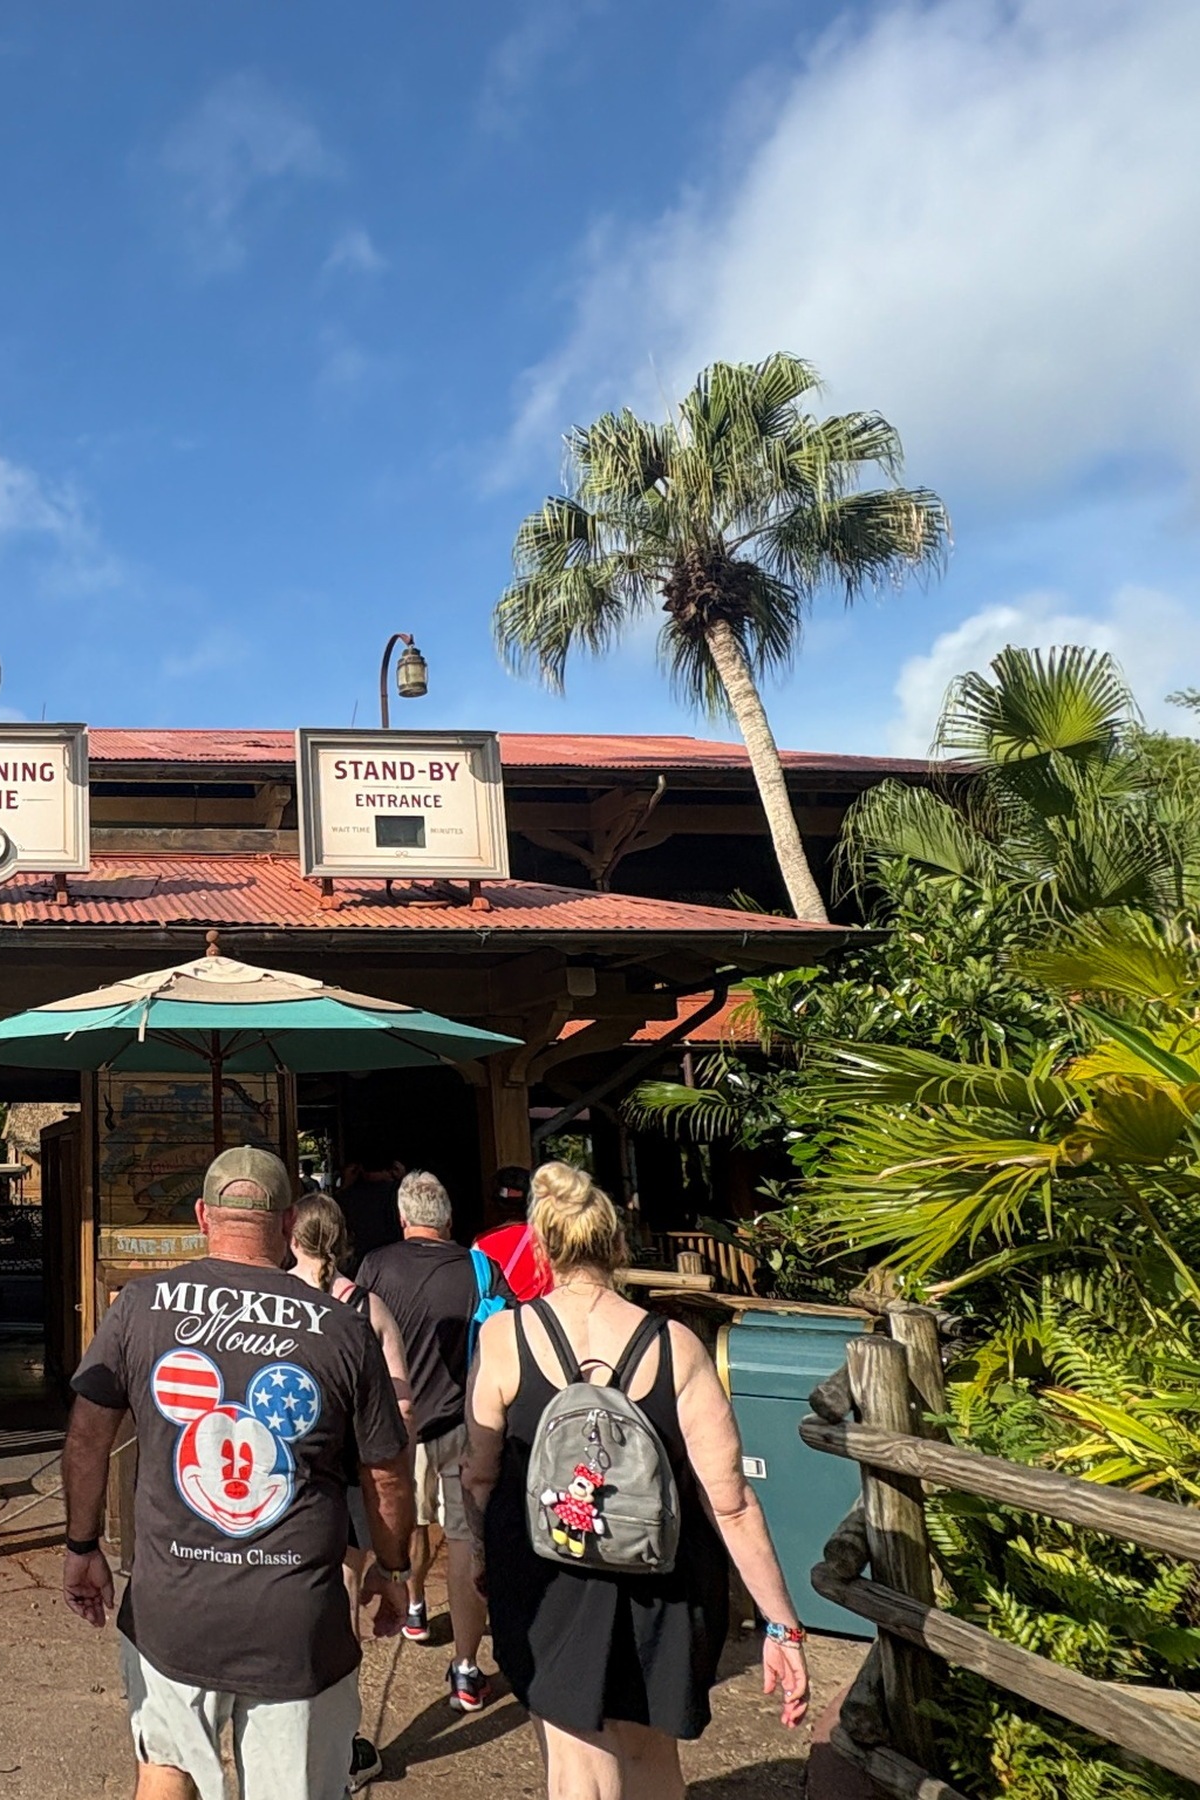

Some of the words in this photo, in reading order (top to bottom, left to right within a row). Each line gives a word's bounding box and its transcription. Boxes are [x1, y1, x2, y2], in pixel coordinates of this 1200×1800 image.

[335, 760, 459, 781] STAND-BY
[356, 794, 442, 808] ENTRANCE
[430, 827, 463, 835] MINUTES
[151, 1282, 332, 1335] MICKEY
[175, 1302, 299, 1358] Mouse
[170, 1541, 242, 1565] American
[247, 1550, 301, 1565] Classic
